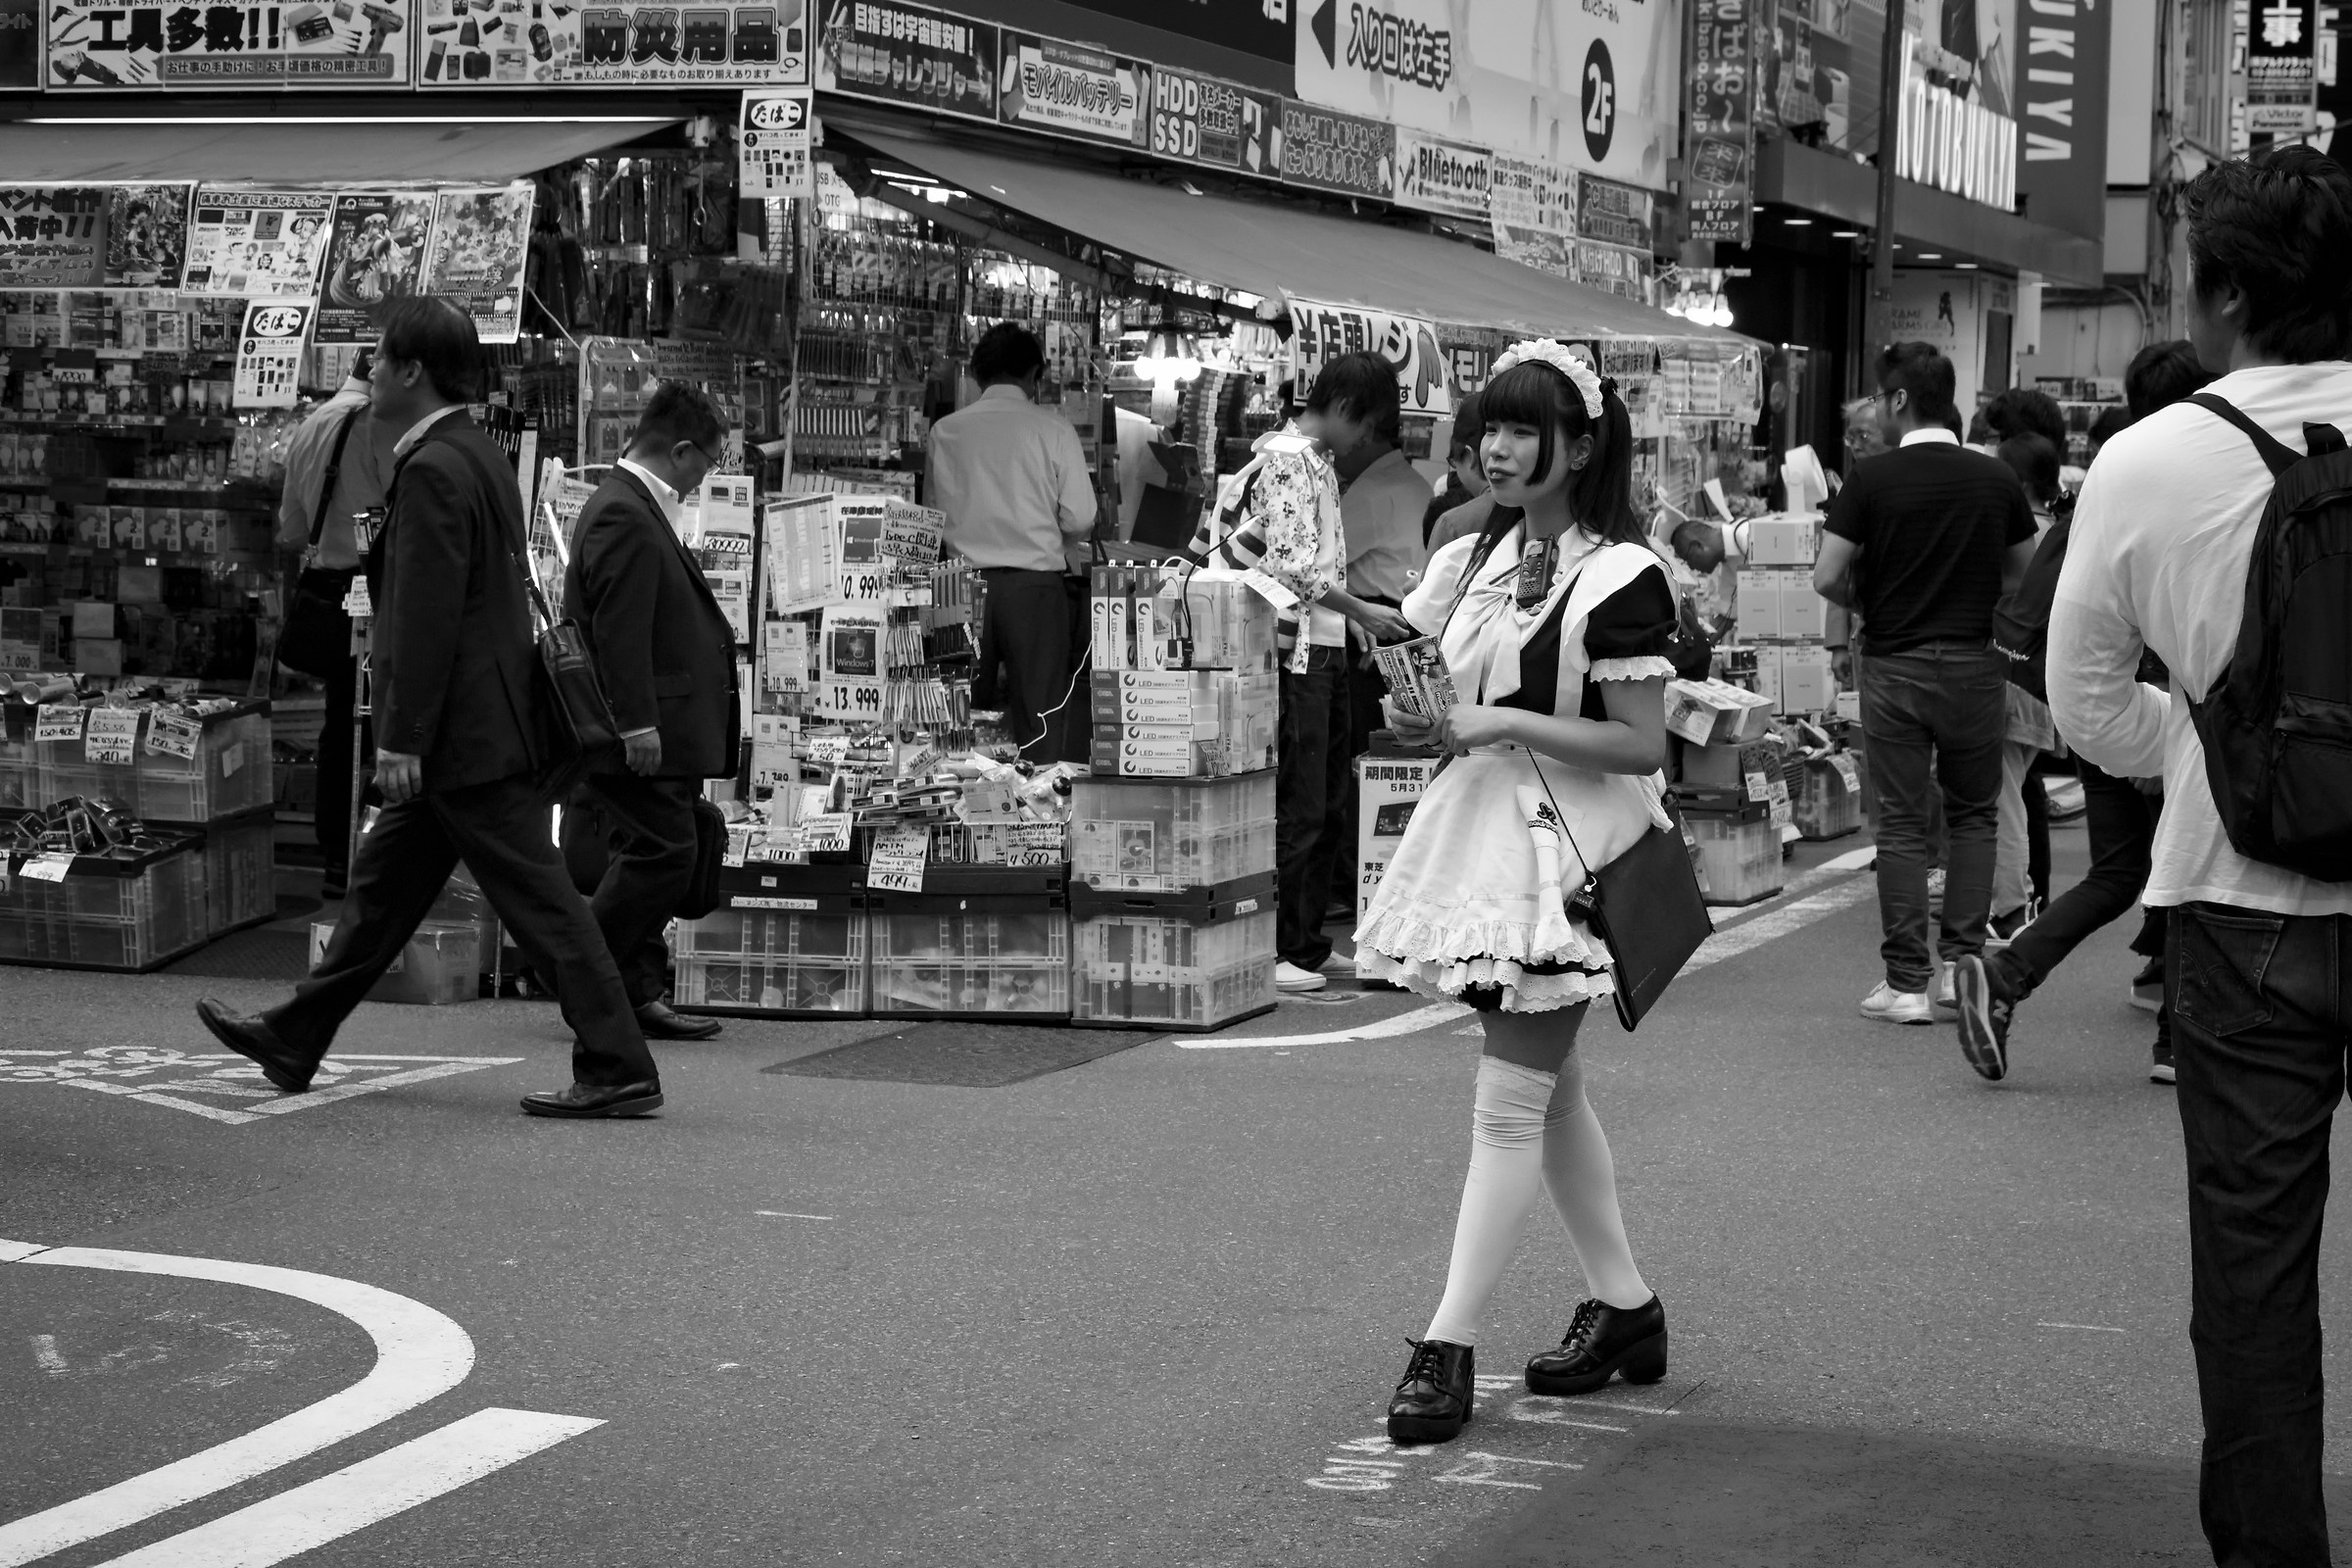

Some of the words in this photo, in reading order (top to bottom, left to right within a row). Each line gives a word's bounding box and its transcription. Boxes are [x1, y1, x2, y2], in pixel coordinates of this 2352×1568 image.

[581, 8, 781, 66] 防災用品
[1348, 7, 1451, 92] 入り口は左手
[1023, 63, 1133, 116] モバイルバッテリー
[1156, 72, 1199, 117] HDD
[1586, 62, 1611, 136] 2F
[754, 104, 800, 123] たばこ
[1154, 113, 1198, 157] SSD
[1895, 29, 2017, 213] KOTOBUKIYA
[1420, 147, 1488, 191] Bluetooth
[255, 312, 302, 330] たばこ
[836, 658, 868, 668] Windows
[1364, 861, 1384, 872] 東芝
